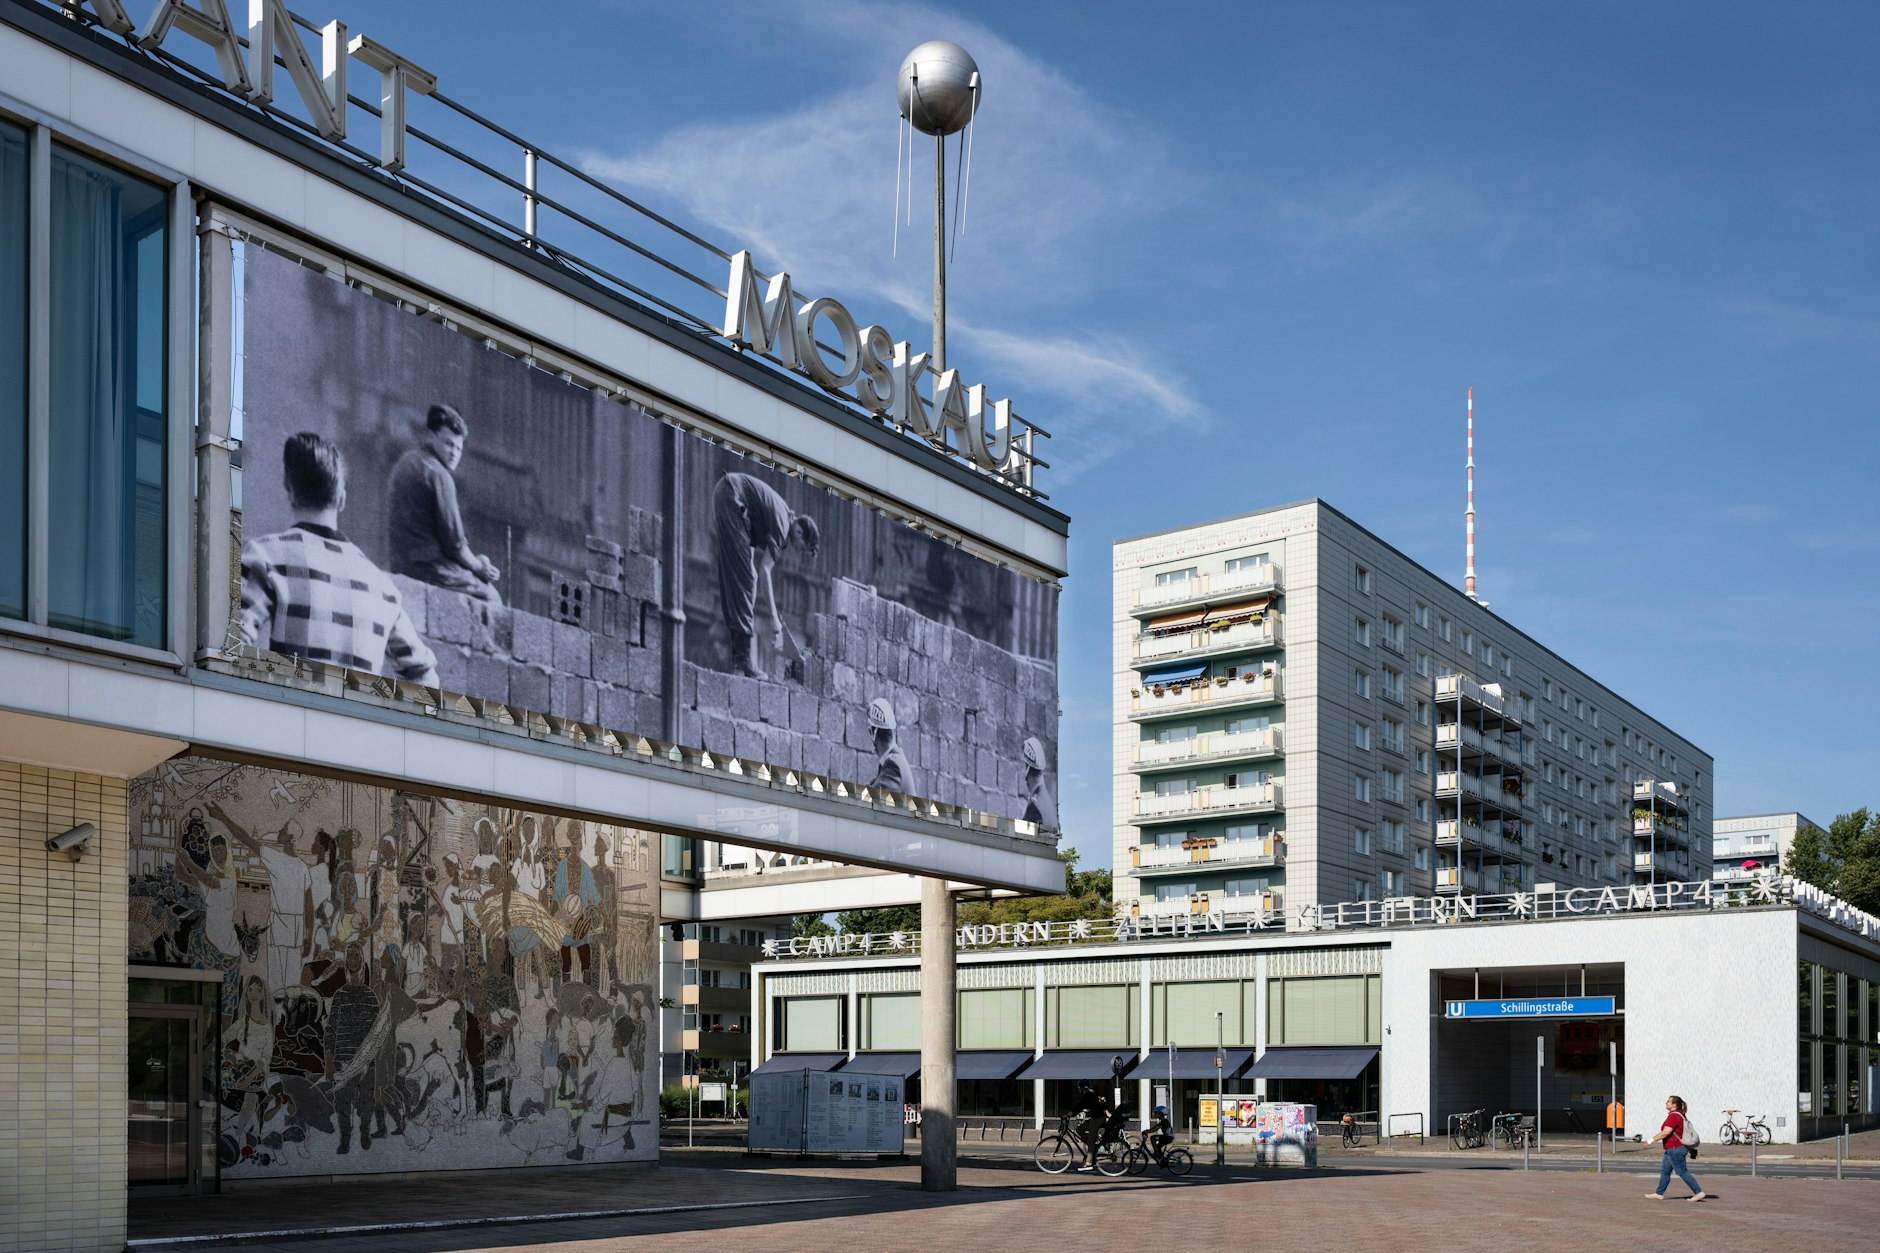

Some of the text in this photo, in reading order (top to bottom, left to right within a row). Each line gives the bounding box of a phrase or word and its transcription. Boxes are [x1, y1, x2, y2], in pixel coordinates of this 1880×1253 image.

[50, 0, 437, 171] ANT
[723, 249, 1013, 471] MOSKAU
[1296, 894, 1477, 927] KLETTERN
[1450, 1000, 1574, 1016] U Schillingstraße
